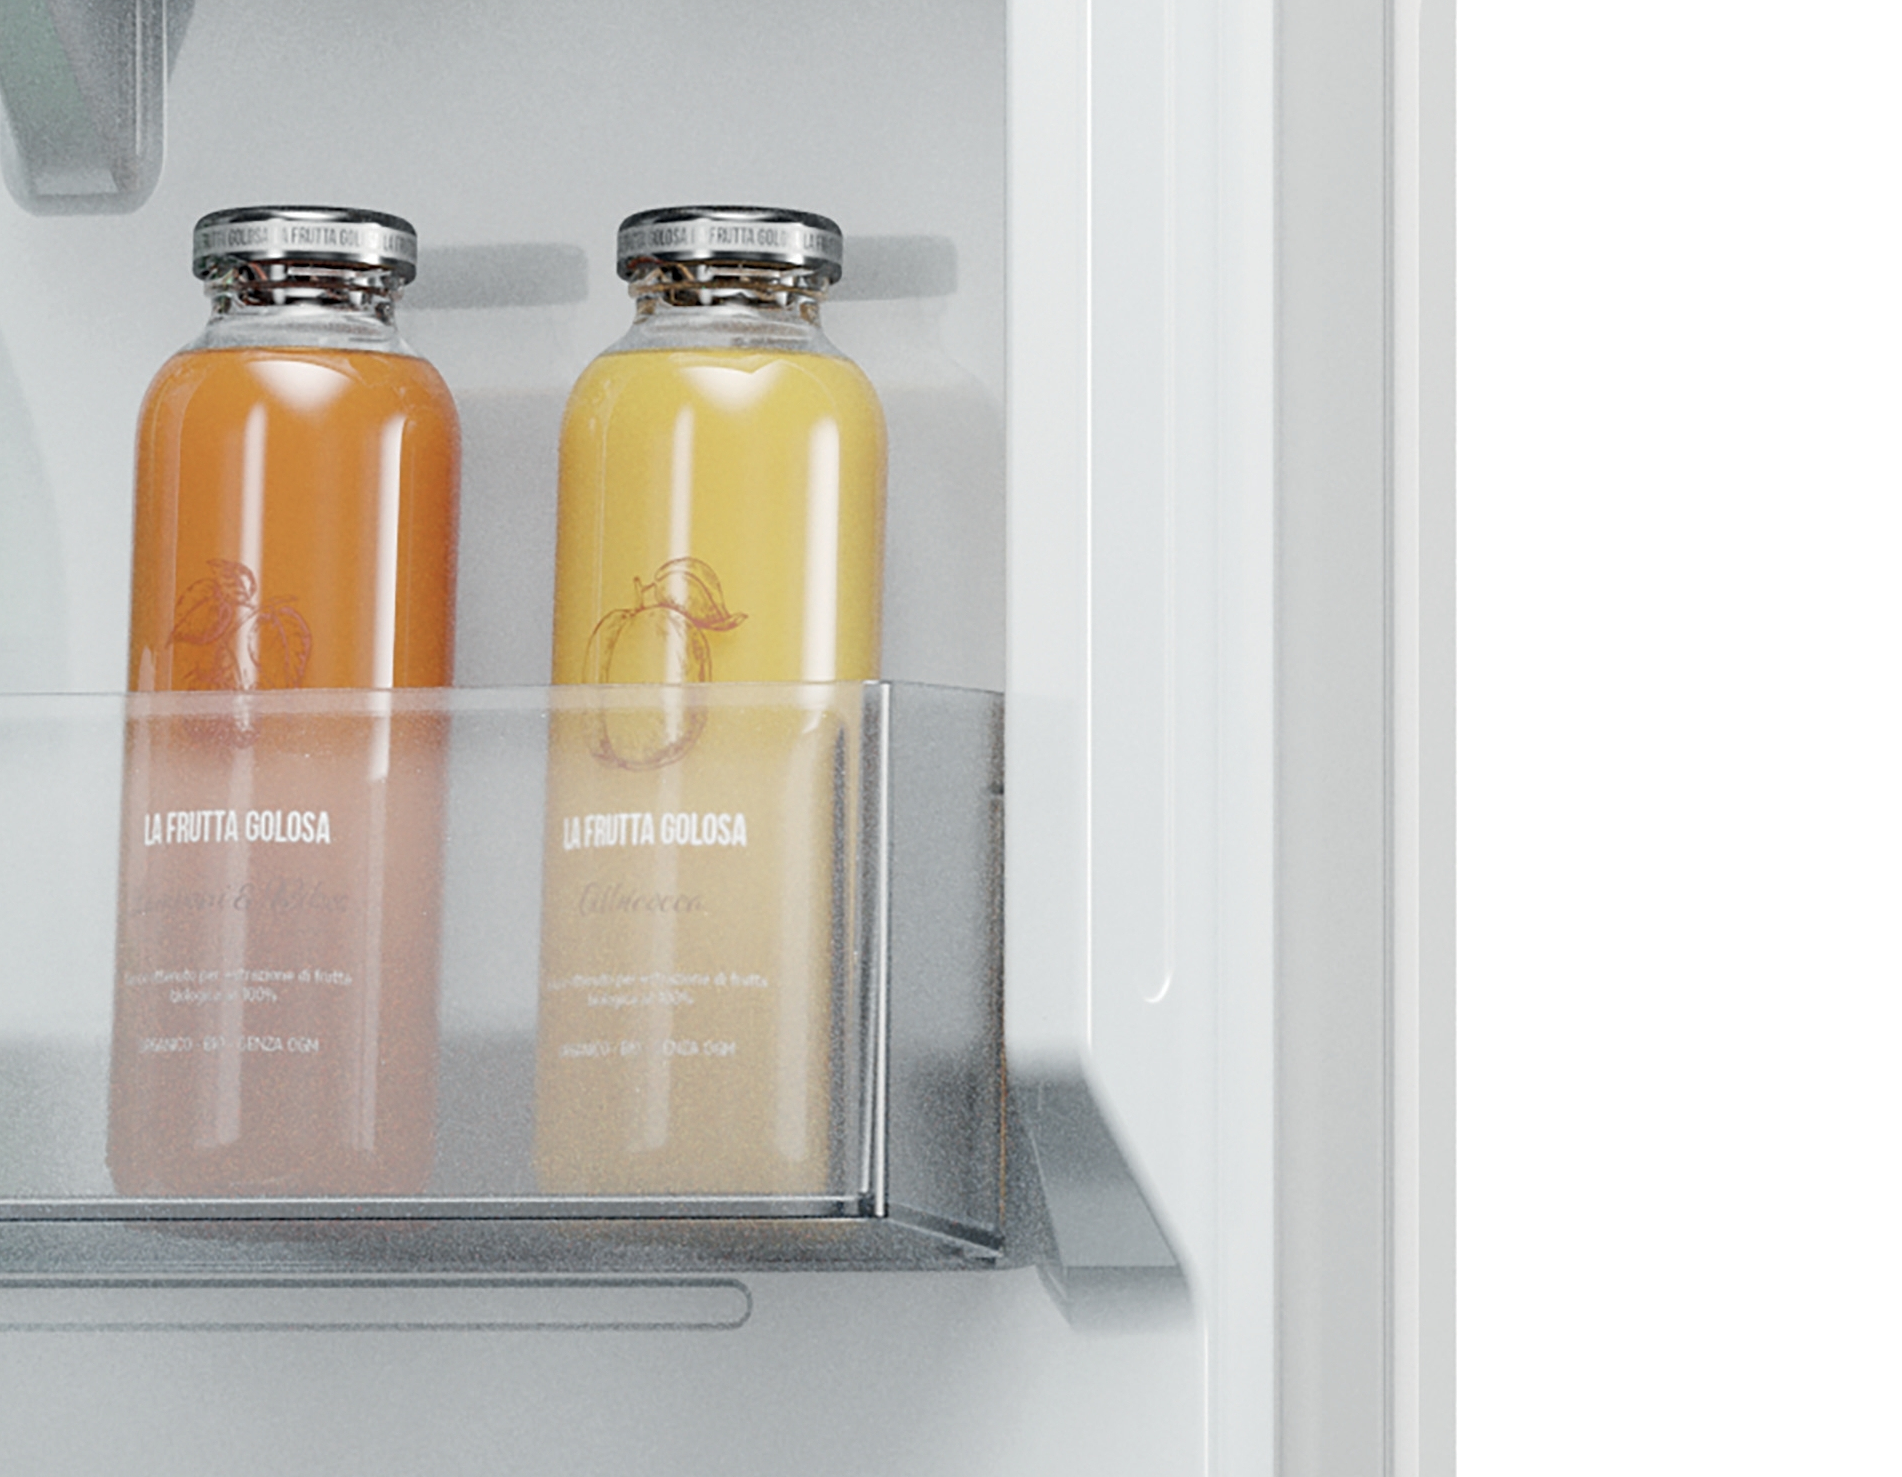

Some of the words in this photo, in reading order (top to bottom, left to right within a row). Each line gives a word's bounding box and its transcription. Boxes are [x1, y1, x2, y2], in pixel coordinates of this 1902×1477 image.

[290, 227, 337, 245] FRUTTA
[707, 227, 755, 245] FRUTTA
[144, 811, 163, 847] LA
[166, 809, 239, 844] FRUTTA
[245, 809, 331, 844] GOLOSA
[563, 816, 581, 851] LA
[584, 812, 655, 848] FRUTTA
[660, 812, 748, 847] GOLOSA
